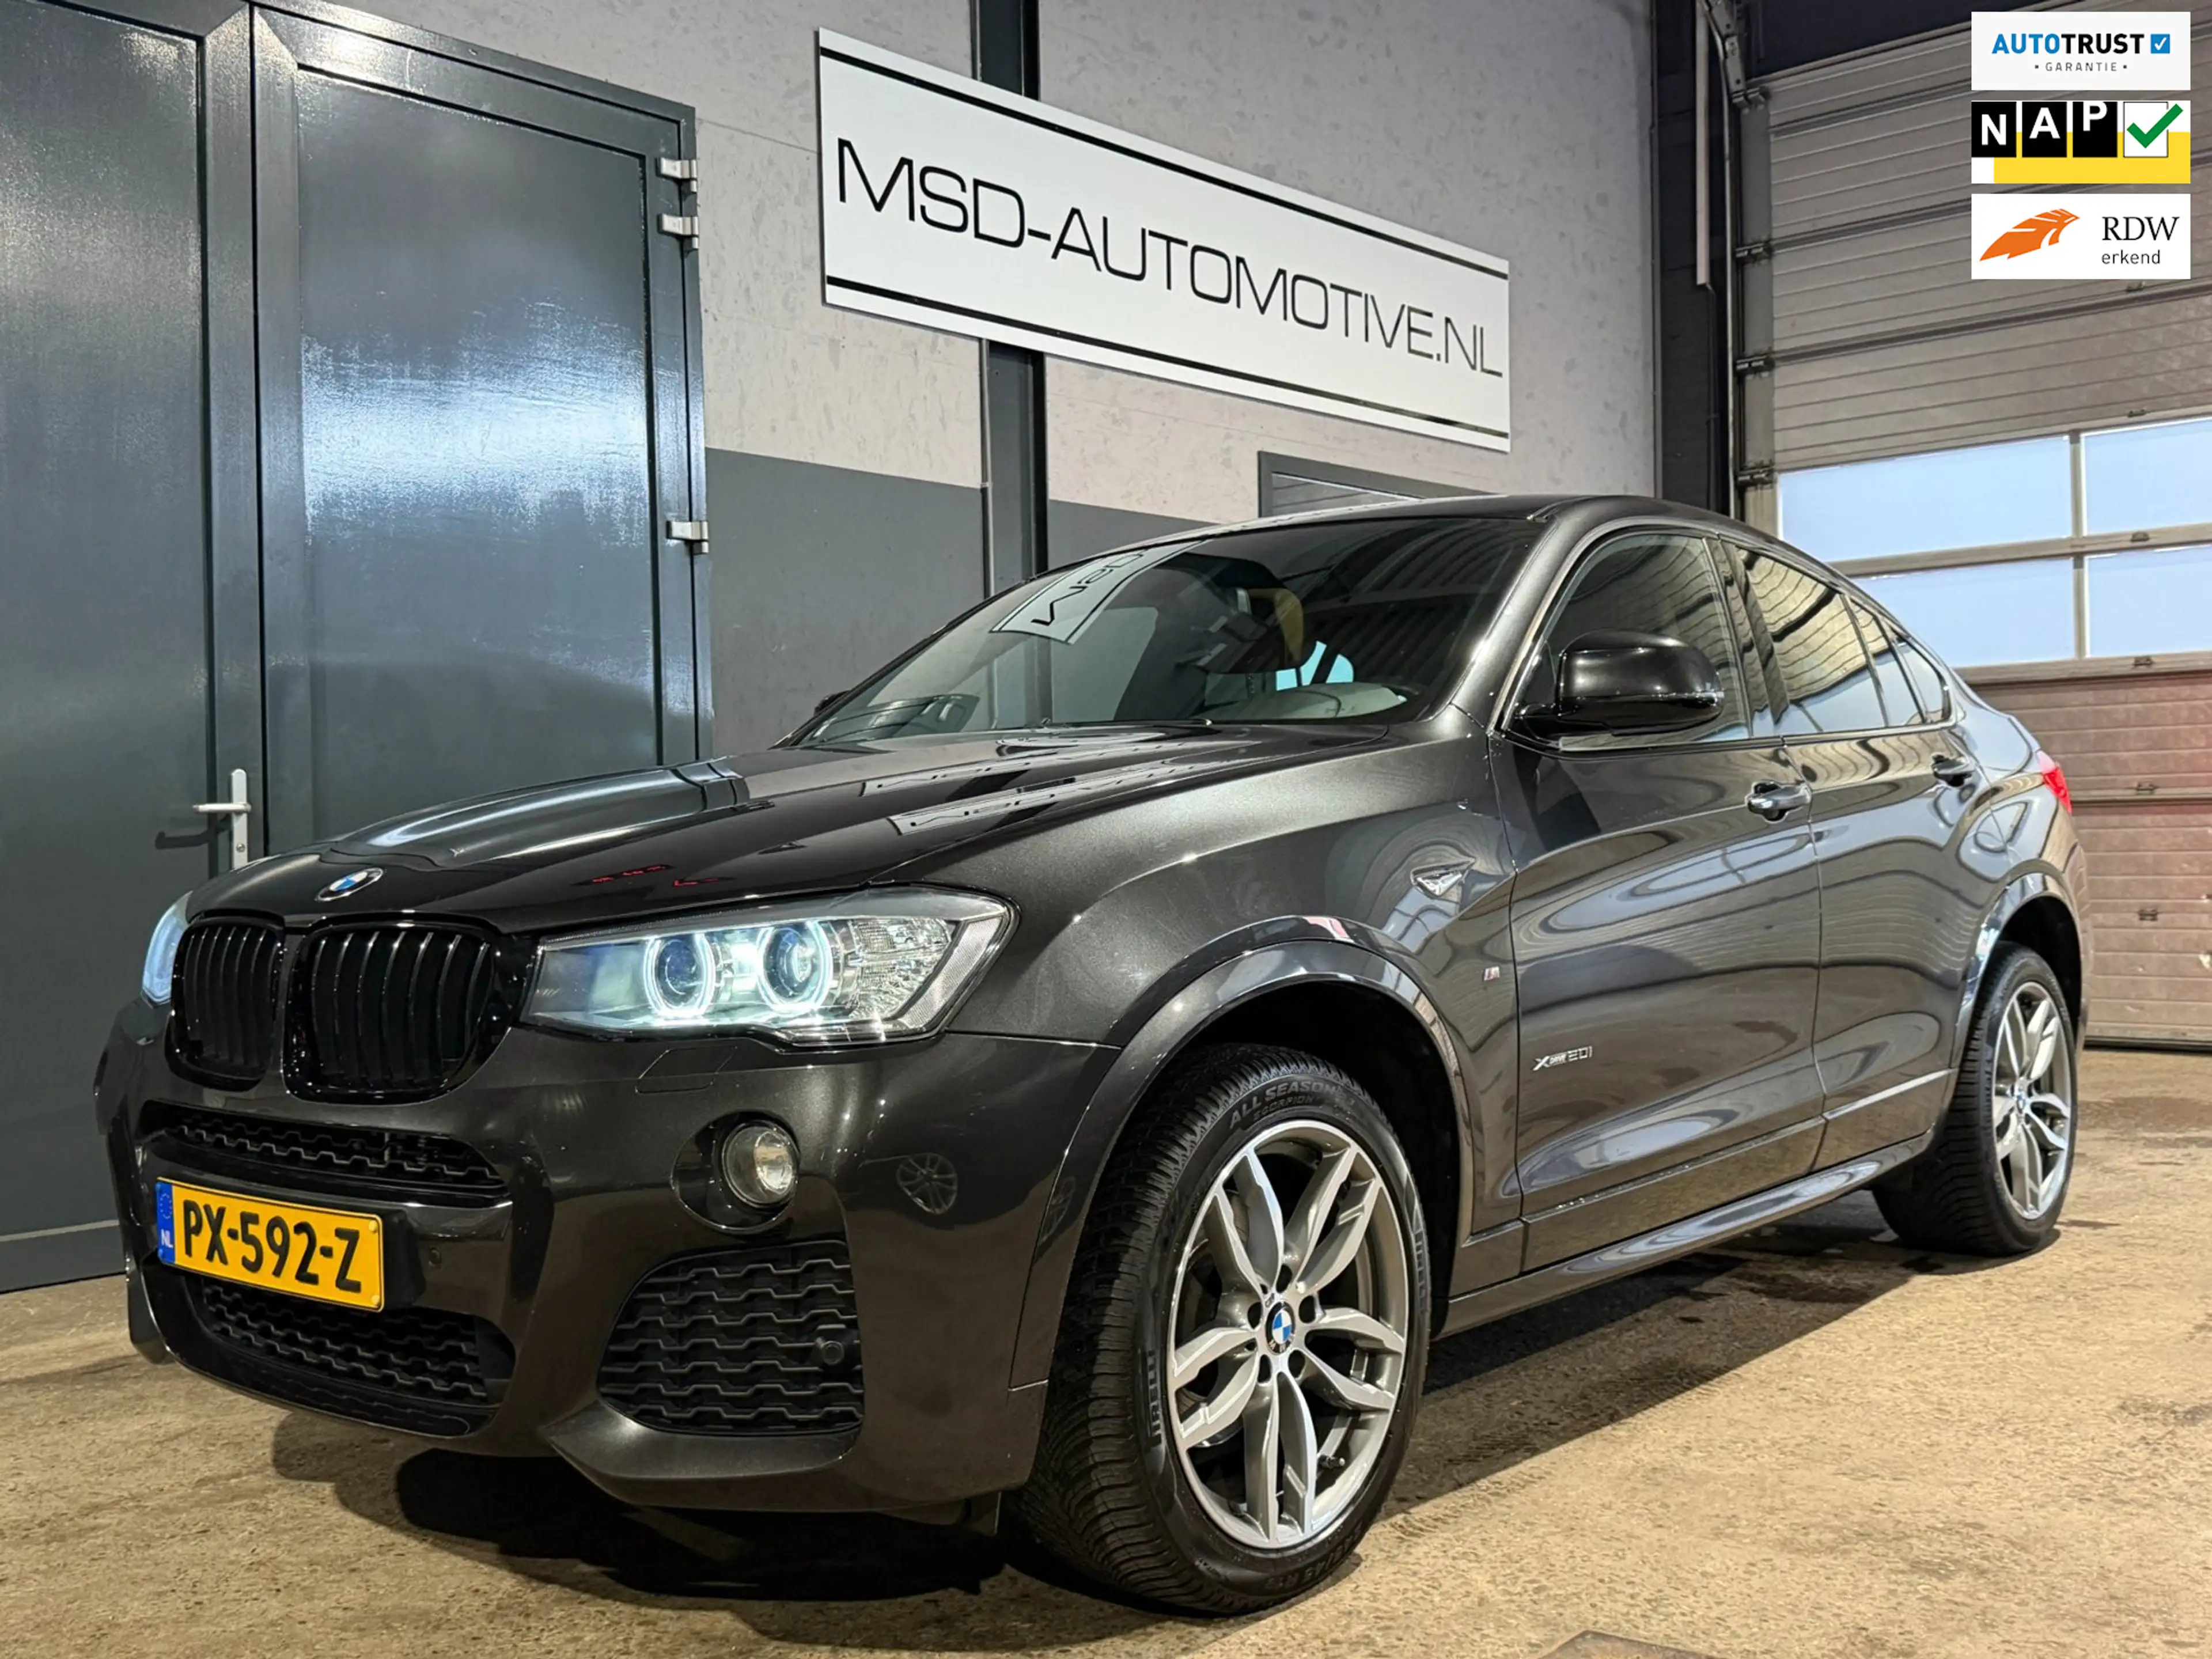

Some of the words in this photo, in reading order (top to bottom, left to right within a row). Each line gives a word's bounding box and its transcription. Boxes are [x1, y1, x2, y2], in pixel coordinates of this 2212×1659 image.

[838, 137, 1503, 377] MSD-AUTOMOTIVE.NL
[1229, 1095, 1262, 1129] ALL
[161, 1229, 174, 1248] NL
[183, 1199, 362, 1293] PX-592-Z
